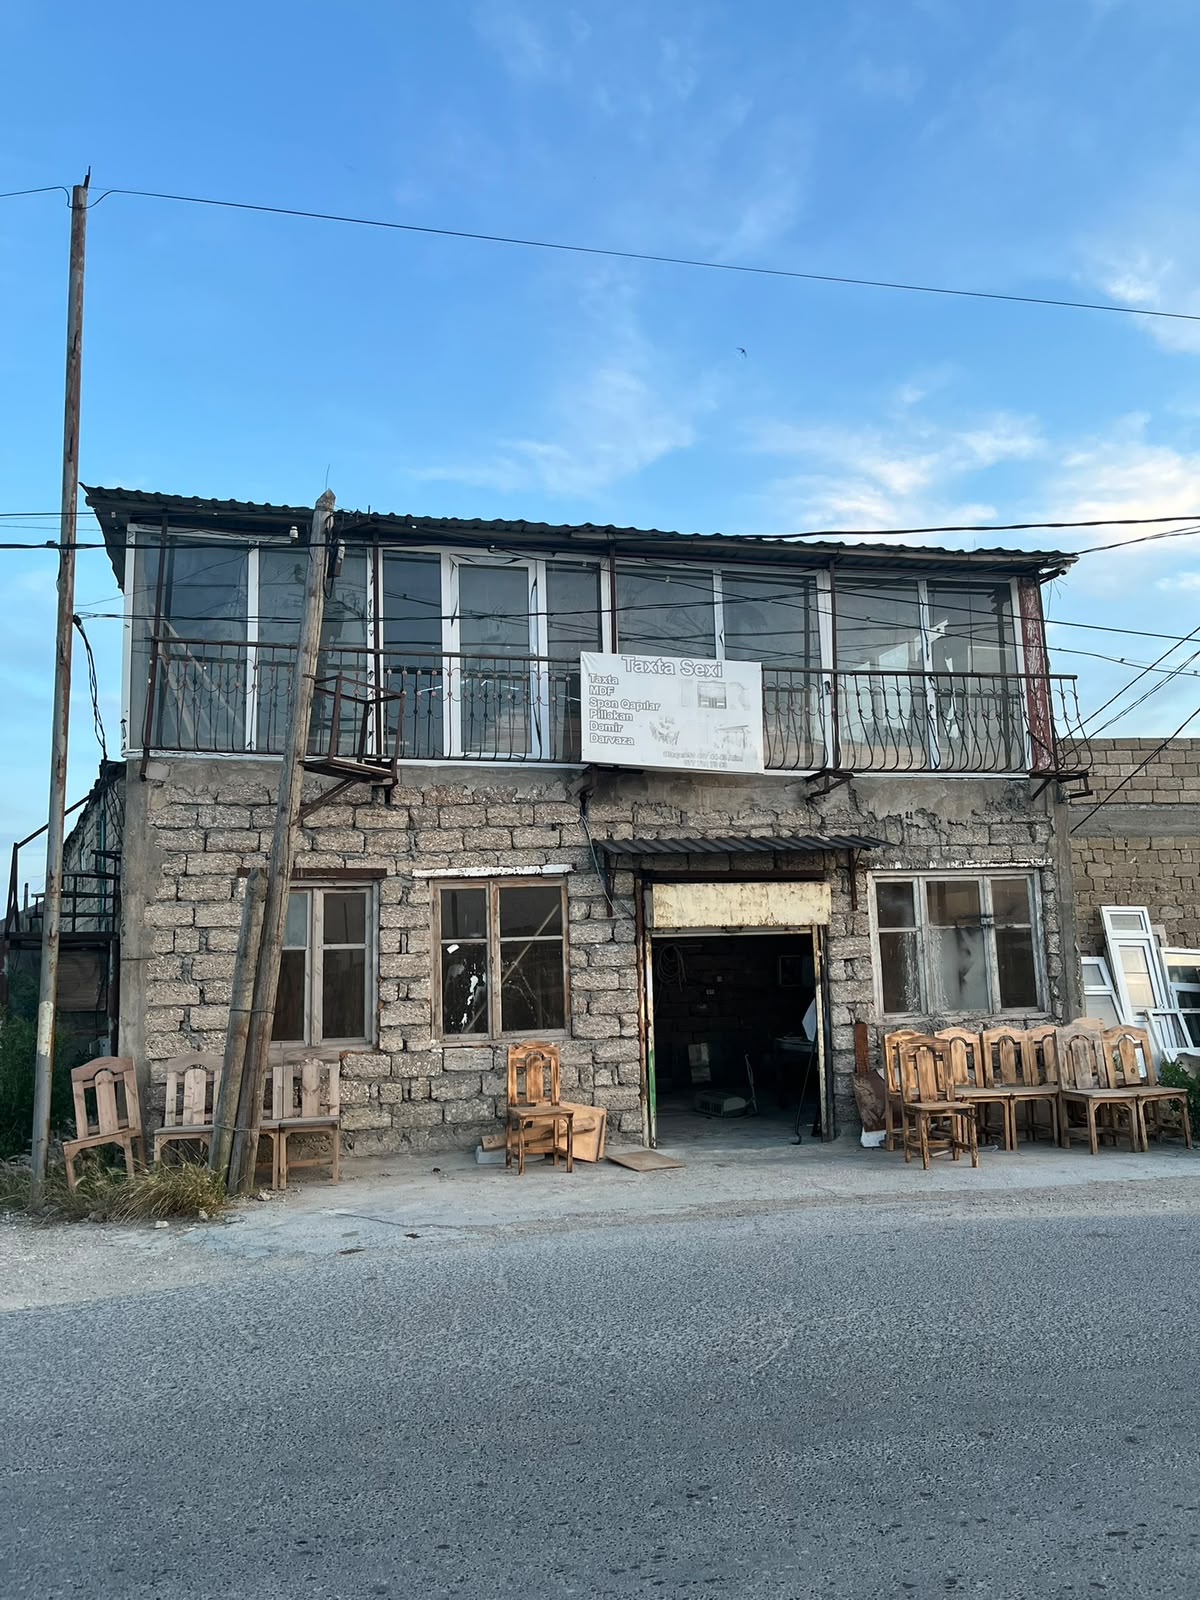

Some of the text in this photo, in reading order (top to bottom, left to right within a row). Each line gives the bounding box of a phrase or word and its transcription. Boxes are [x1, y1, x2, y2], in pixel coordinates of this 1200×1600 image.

[621, 656, 723, 678] Taxta Sexi
[588, 673, 619, 685] Taxta
[589, 685, 615, 696] MDF
[589, 697, 661, 712] Spon Qapılar
[590, 733, 635, 746] Darvaza
